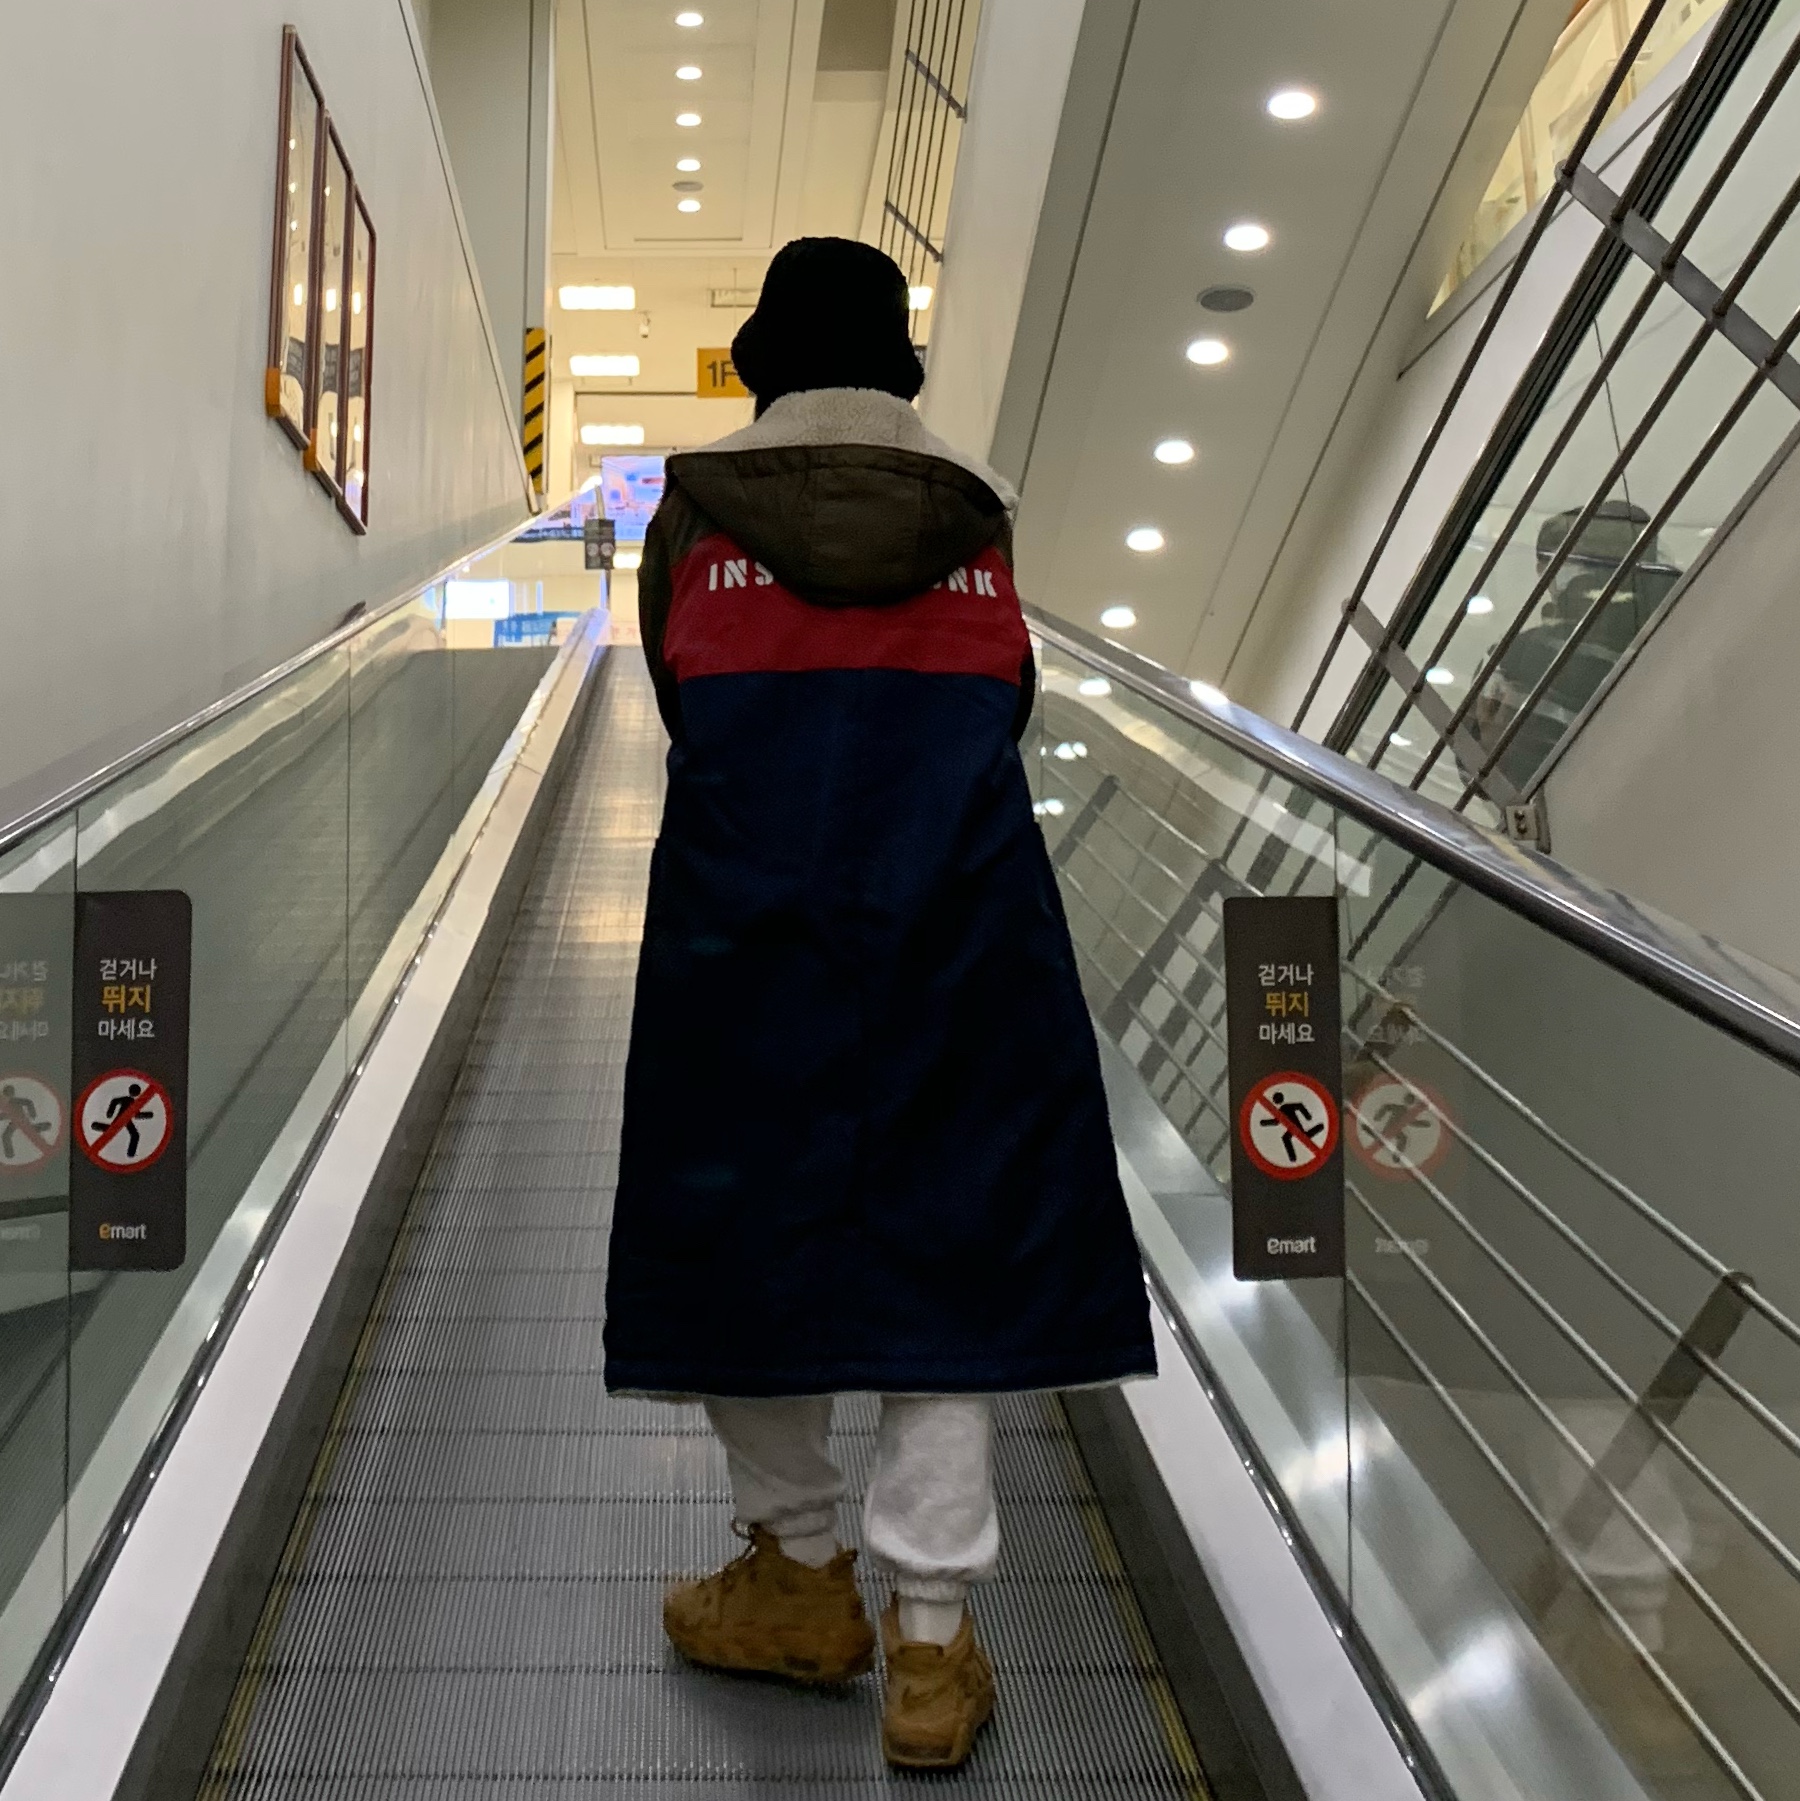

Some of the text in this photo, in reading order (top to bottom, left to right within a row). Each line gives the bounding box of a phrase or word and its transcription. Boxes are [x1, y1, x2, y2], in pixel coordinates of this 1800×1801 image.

[706, 360, 739, 388] 1F
[932, 566, 998, 598] NK
[99, 957, 158, 981] 걷거나
[1257, 963, 1315, 987] 걷거나
[101, 984, 152, 1014] 뛰지
[1264, 991, 1310, 1018] 뛰지
[97, 1017, 156, 1041] 마세요
[1258, 1022, 1316, 1046] 마세요
[98, 1222, 147, 1240] emart
[1266, 1236, 1317, 1255] emart
